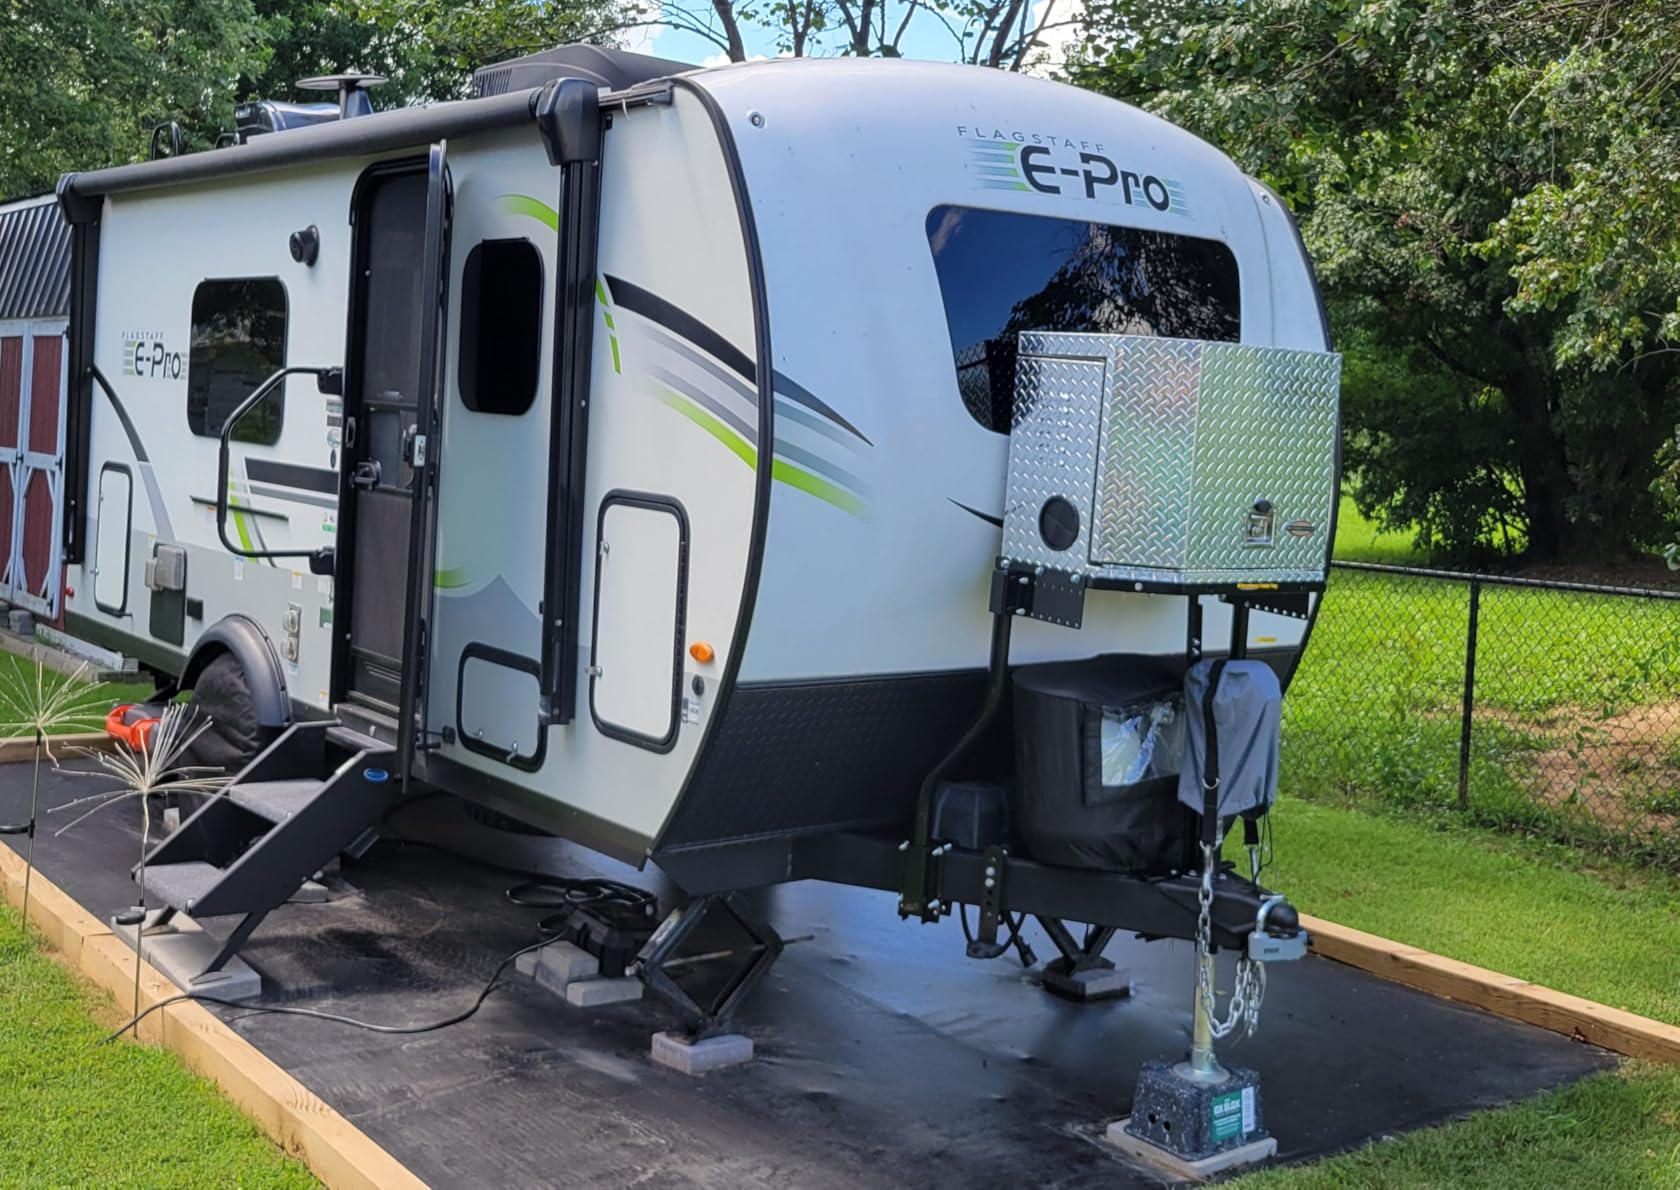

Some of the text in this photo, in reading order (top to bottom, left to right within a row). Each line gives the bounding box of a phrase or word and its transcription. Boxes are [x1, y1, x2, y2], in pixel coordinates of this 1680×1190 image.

[956, 125, 1105, 153] FLAGSTAFF
[1020, 145, 1170, 212] E-Pro
[121, 330, 164, 340] FLAGSTAFF
[134, 341, 181, 380] E-Pro
